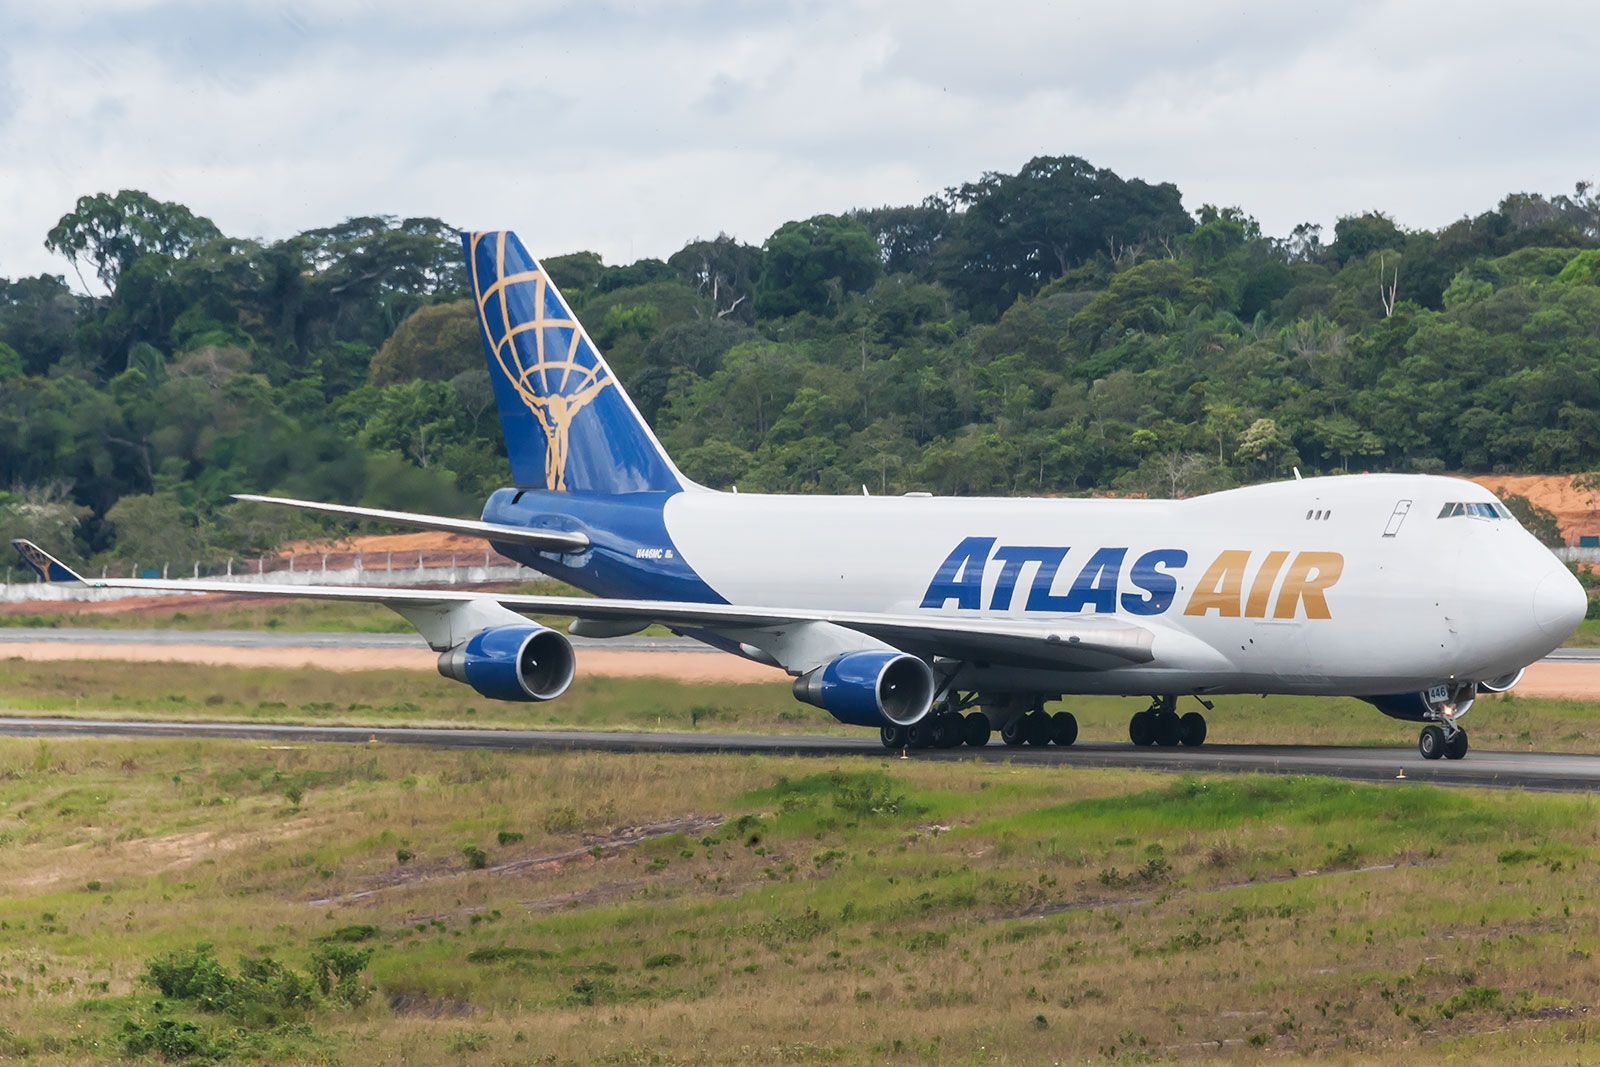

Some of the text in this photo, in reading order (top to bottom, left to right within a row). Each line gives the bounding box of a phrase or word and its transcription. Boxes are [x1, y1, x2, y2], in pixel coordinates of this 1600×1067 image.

[635, 548, 663, 559] N446MC
[919, 536, 1345, 619] ATLAS AIR
[1430, 687, 1446, 698] 446
